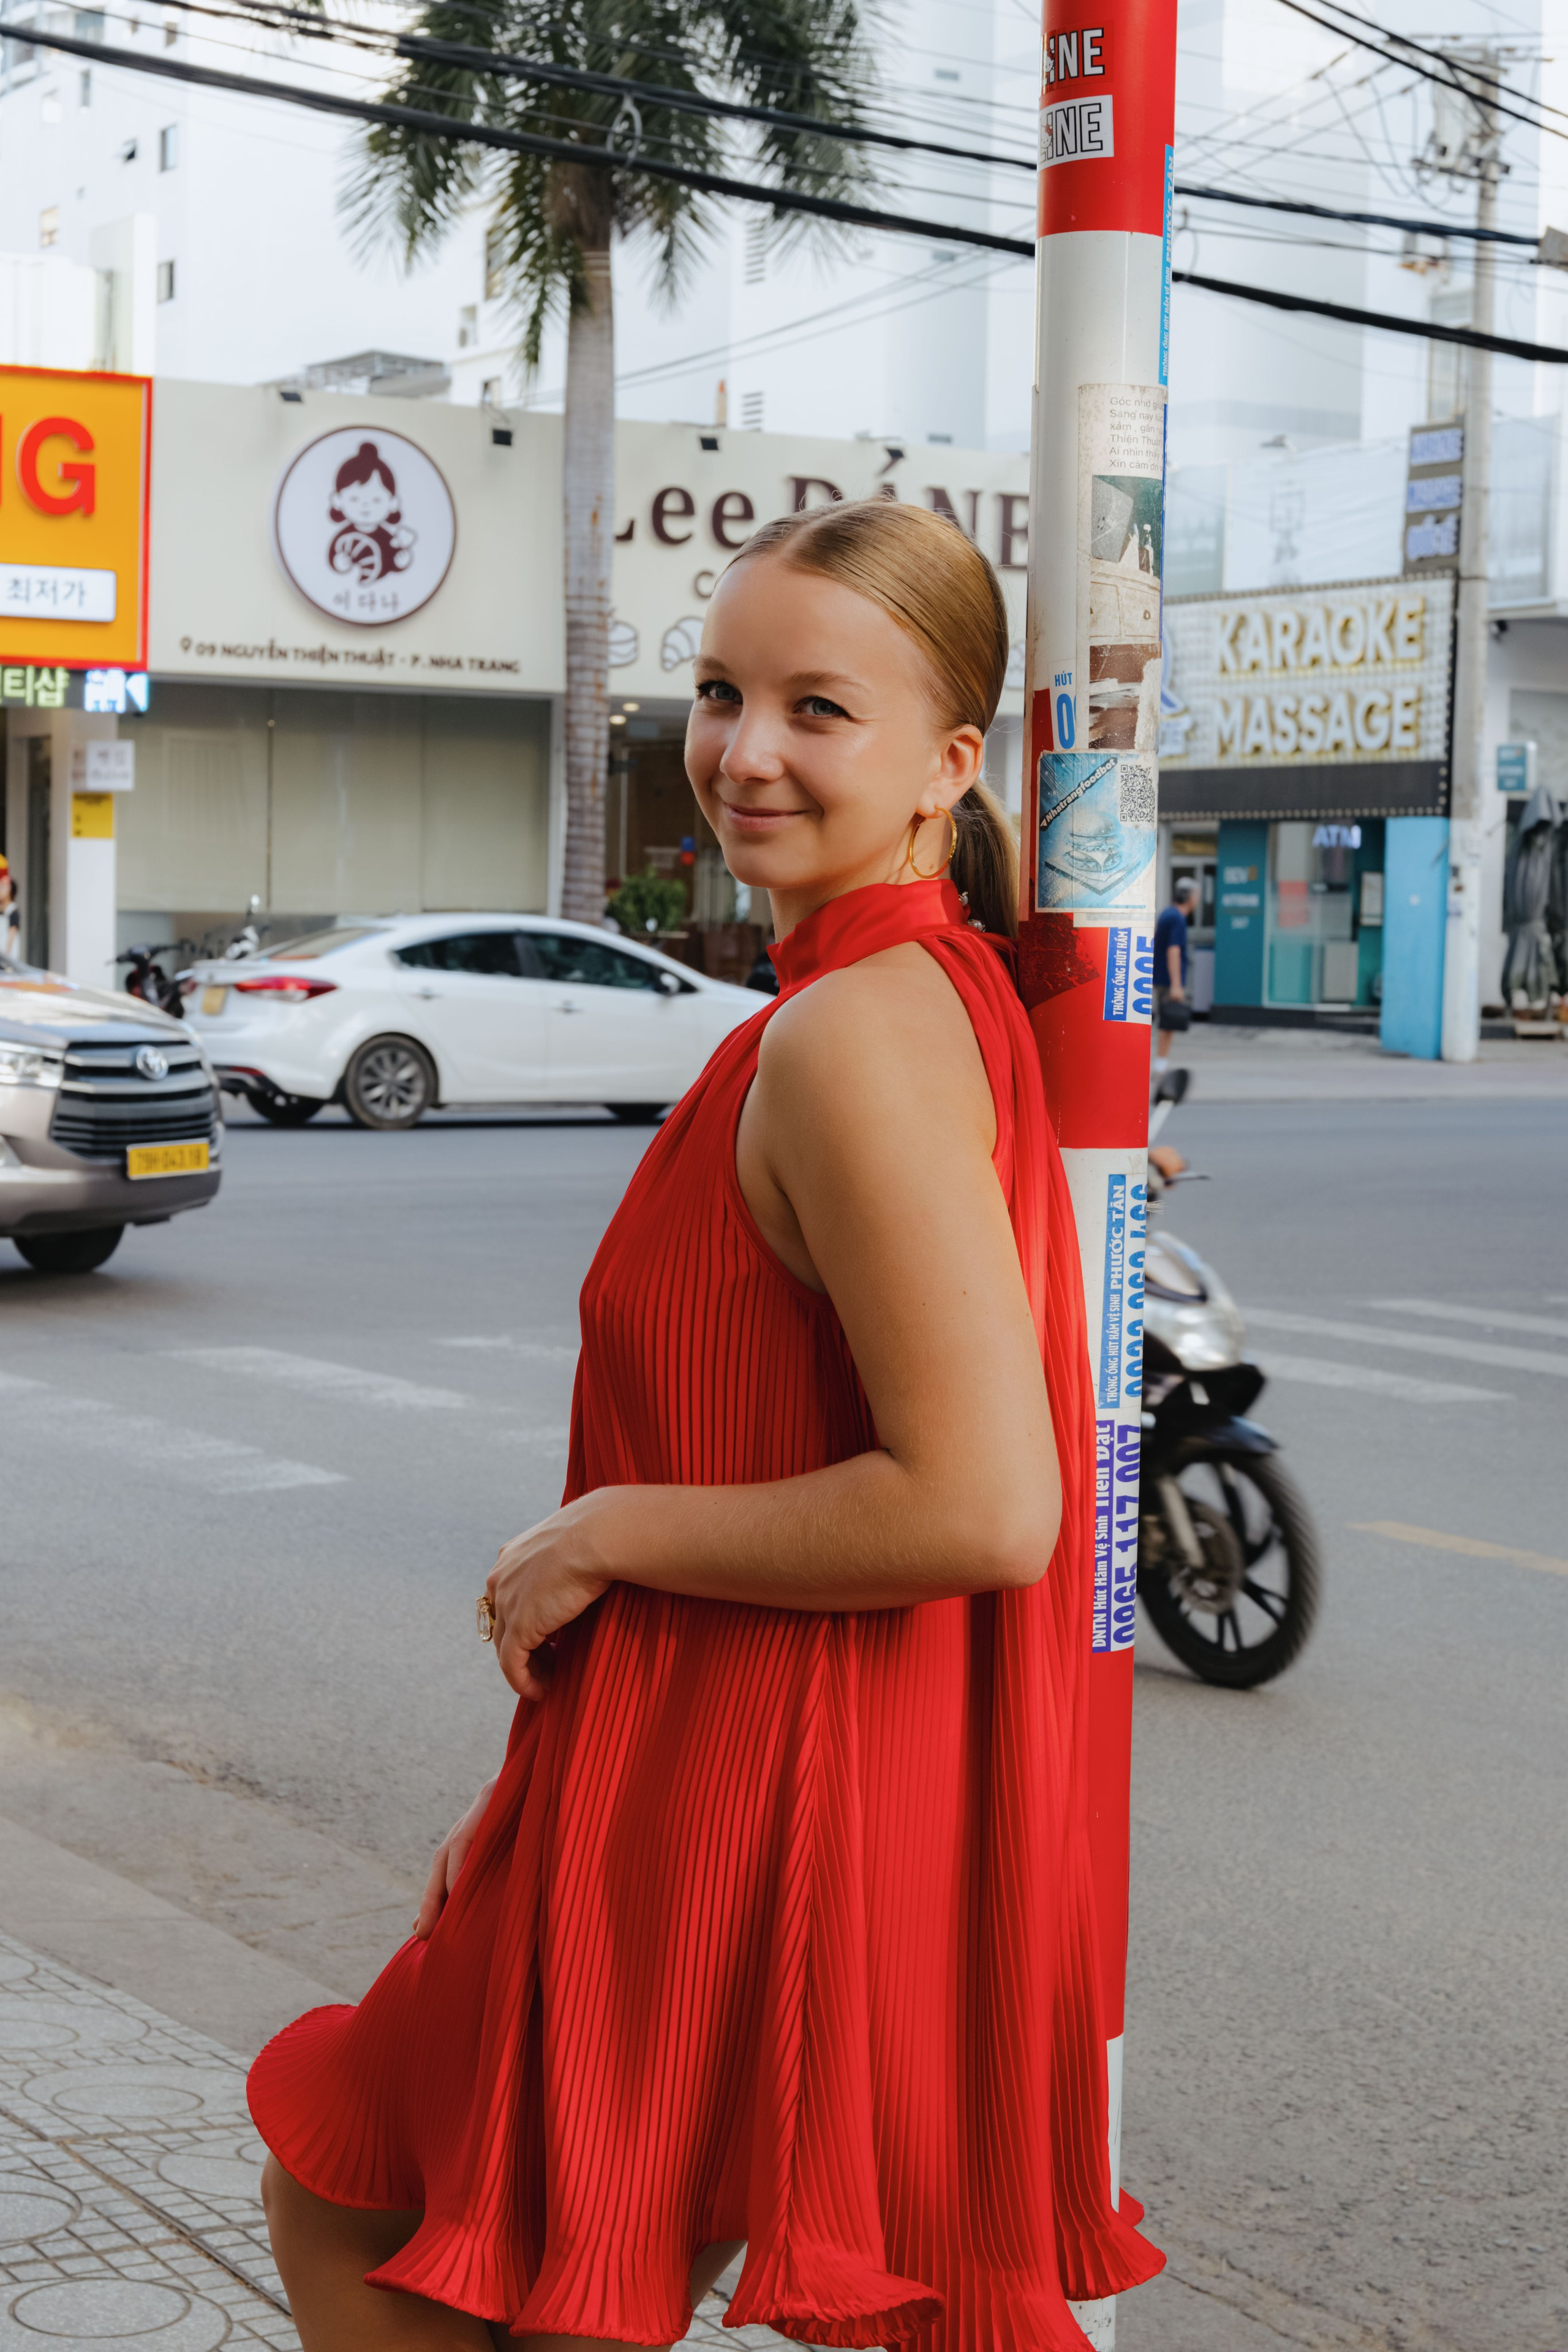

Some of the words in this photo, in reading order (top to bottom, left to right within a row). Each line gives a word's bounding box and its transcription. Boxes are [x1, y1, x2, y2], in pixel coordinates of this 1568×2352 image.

[1042, 28, 1105, 86] INE
[1040, 103, 1103, 164] INE
[1139, 413, 1153, 422] nay
[0, 413, 95, 516] G
[1109, 447, 1120, 455] Ai
[1109, 459, 1126, 468] Xin
[615, 487, 755, 550] ee
[7, 578, 86, 608] 최저가
[1216, 597, 1425, 673] KARAOKE
[0, 665, 70, 707] 티샵
[1054, 671, 1072, 687] HÚT
[1215, 685, 1422, 756] MASSAGE
[1045, 759, 1115, 823] Nhatrangfoodbot
[1114, 949, 1127, 966] HÚT
[1112, 968, 1126, 986] ỐNG
[1112, 987, 1125, 1016] THÔNG
[1110, 1185, 1125, 1222] TÂN
[1109, 1227, 1123, 1289] PHƯỚC
[1110, 1294, 1120, 1312] SINH
[1107, 1313, 1121, 1323] VỆ
[1106, 1341, 1118, 1356] HÚT
[1104, 1357, 1118, 1374] ỐNG
[1105, 1376, 1118, 1403] THÔNG
[1095, 1515, 1108, 1539] Sinh
[1095, 1543, 1110, 1558] Vệ
[1093, 1589, 1107, 1610] Hút
[1092, 1613, 1106, 1648] DNTN
